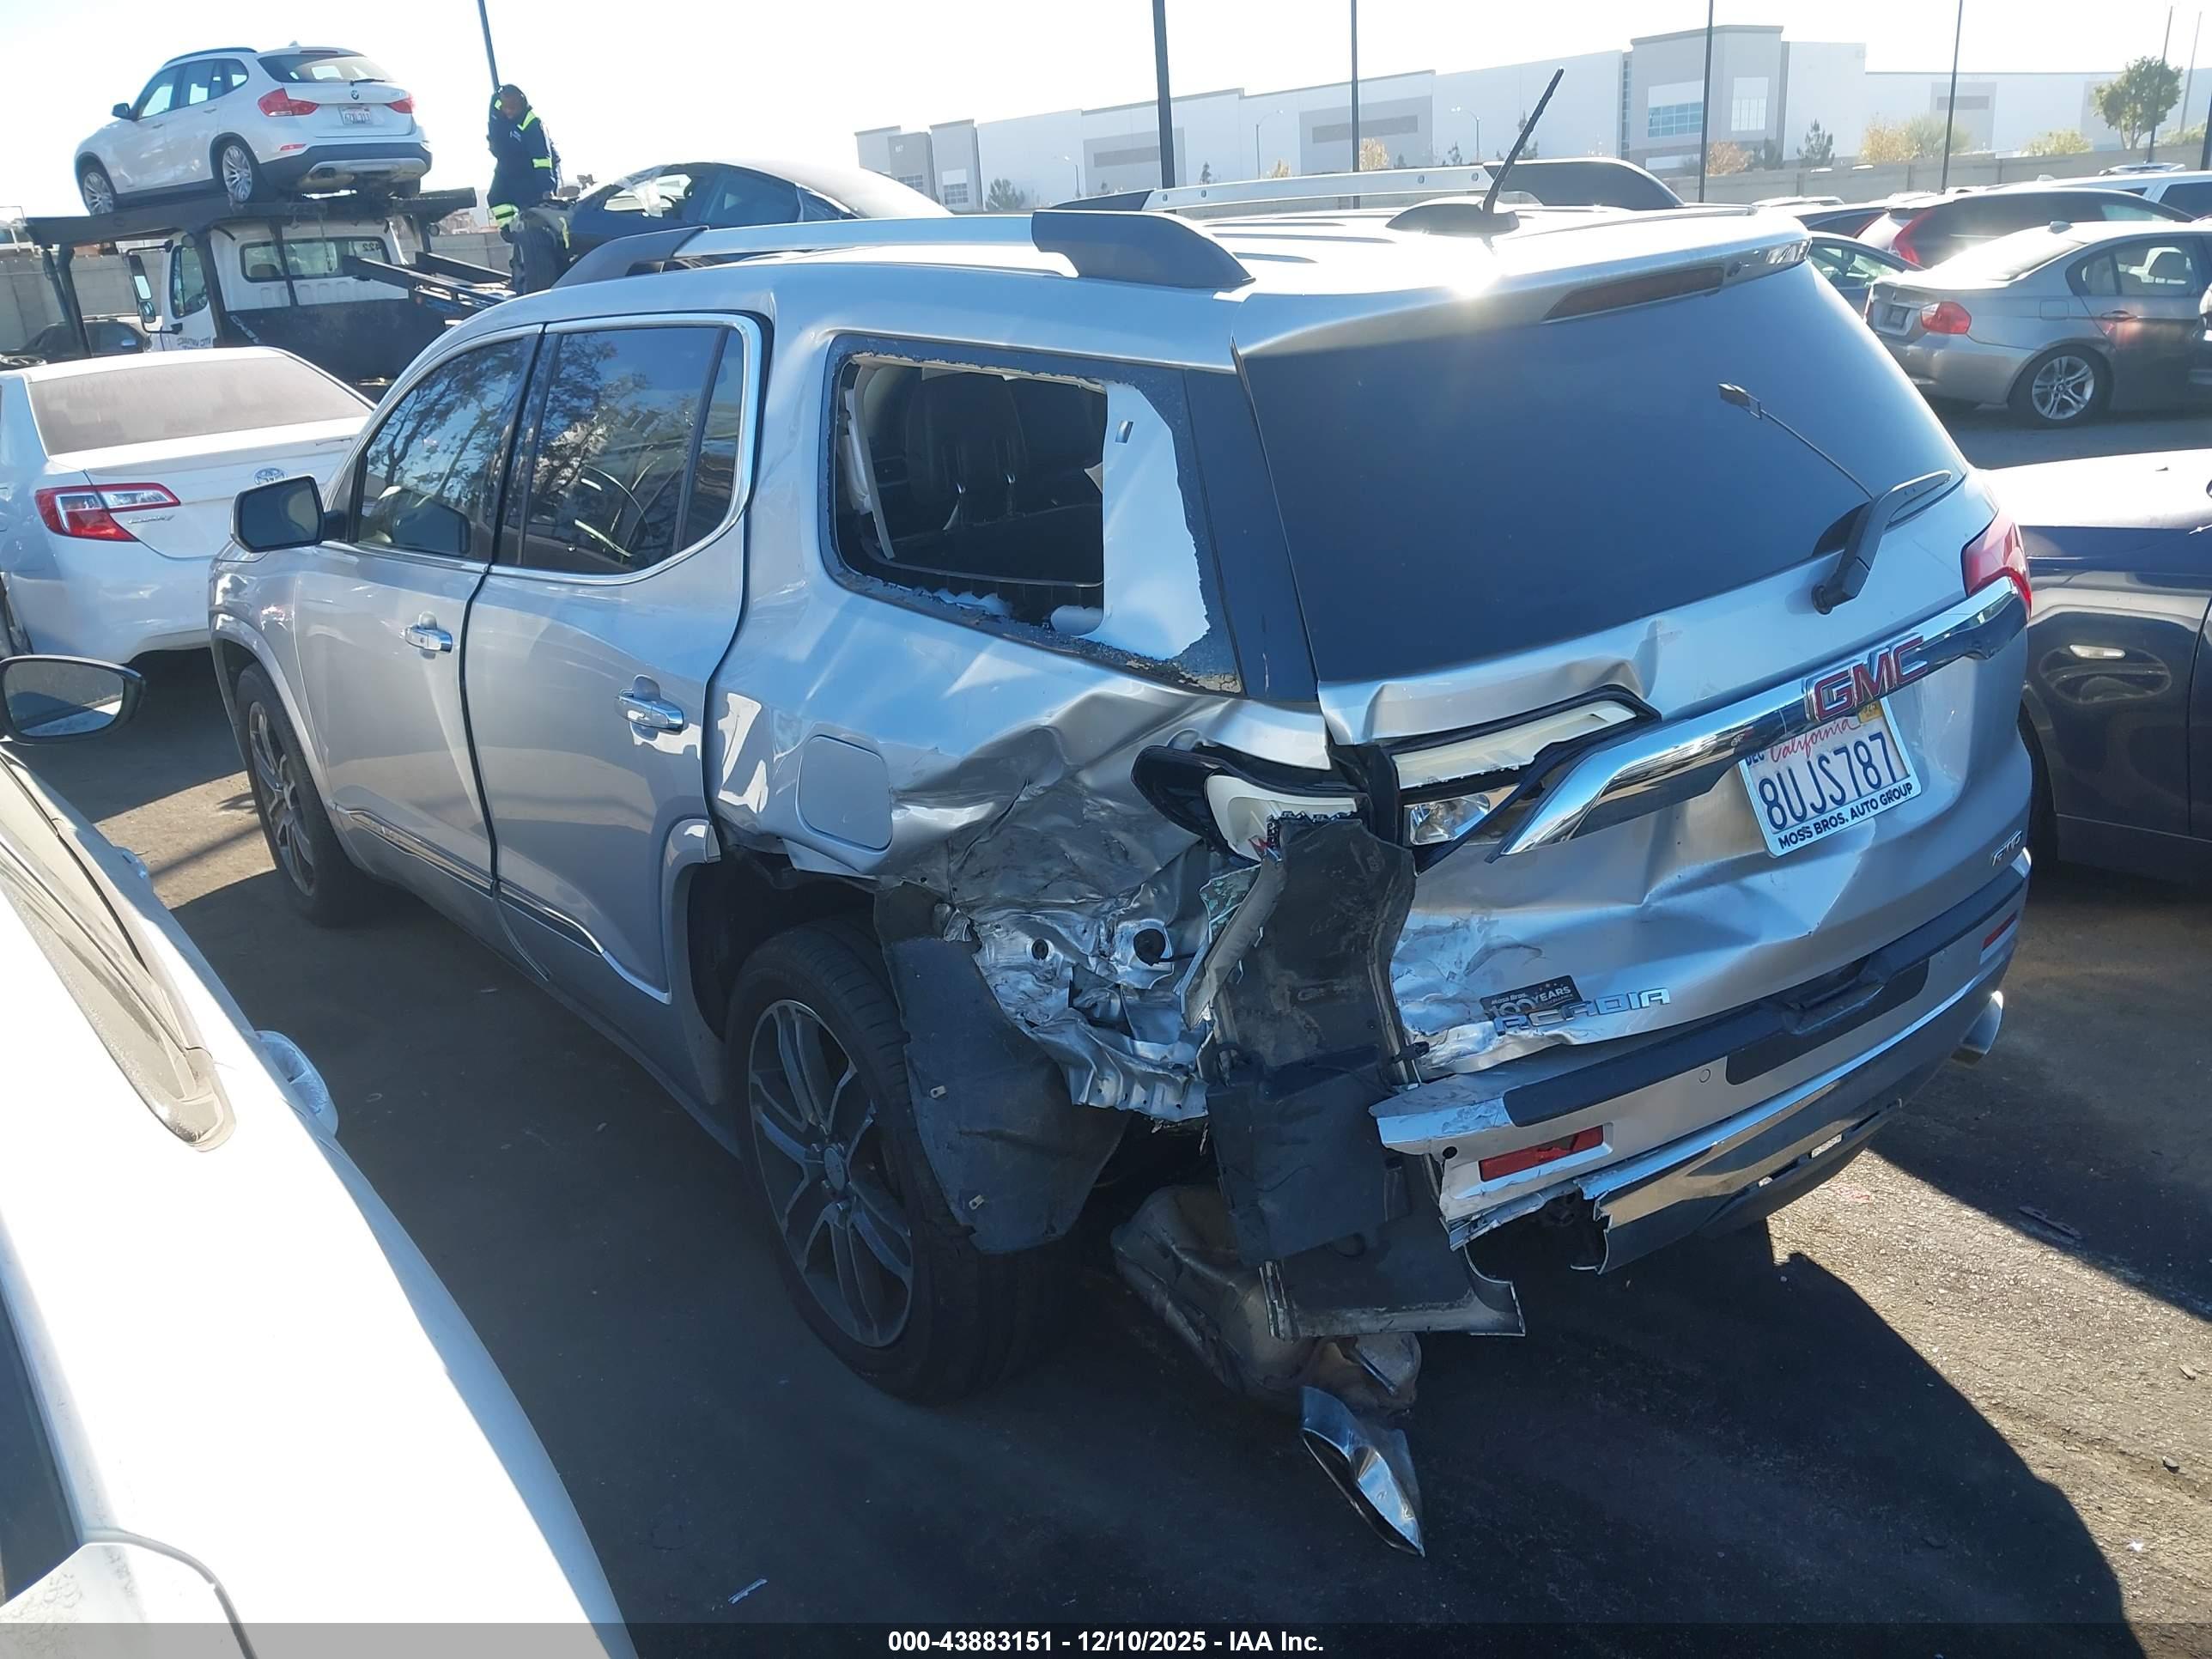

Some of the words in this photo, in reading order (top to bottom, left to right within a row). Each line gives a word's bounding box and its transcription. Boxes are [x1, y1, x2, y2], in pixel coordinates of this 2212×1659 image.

[1808, 634, 1928, 721] GMC
[1745, 749, 1765, 767] DEC
[1771, 718, 1861, 763] California
[1759, 732, 1897, 830] 8UJS787
[1778, 825, 1814, 849] MOSS
[1813, 812, 1849, 835] BROS.
[1850, 798, 1879, 820] AUTO
[1879, 782, 1913, 805] GROUP
[1494, 988, 1670, 1036] ACADIA
[1531, 986, 1571, 1003] YEARS
